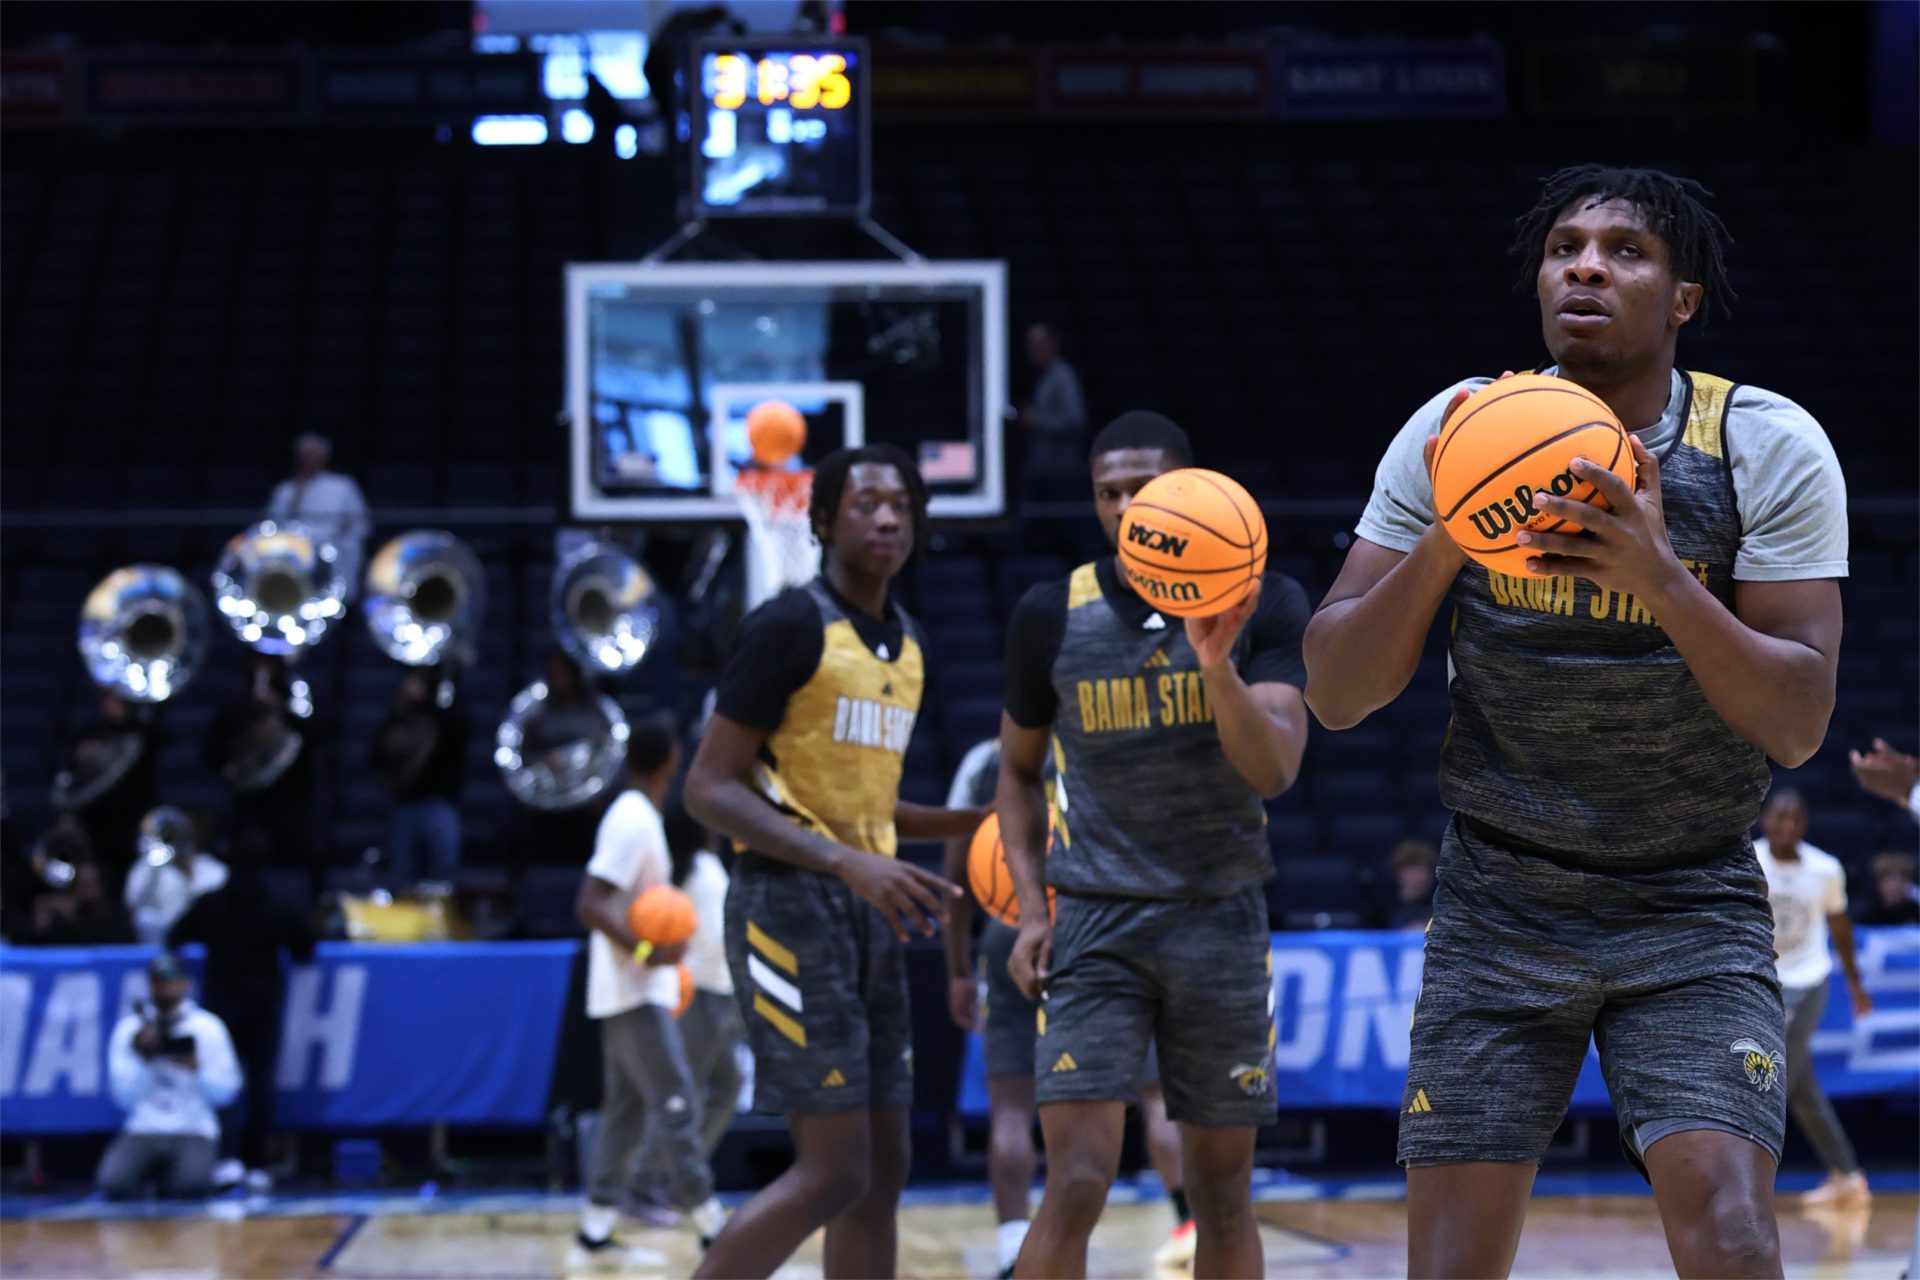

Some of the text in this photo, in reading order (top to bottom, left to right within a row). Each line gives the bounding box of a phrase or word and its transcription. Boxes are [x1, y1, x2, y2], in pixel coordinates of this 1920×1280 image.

[1468, 462, 1586, 540] Wilo
[1128, 521, 1188, 557] NCAA
[1077, 676, 1150, 734] BAMA
